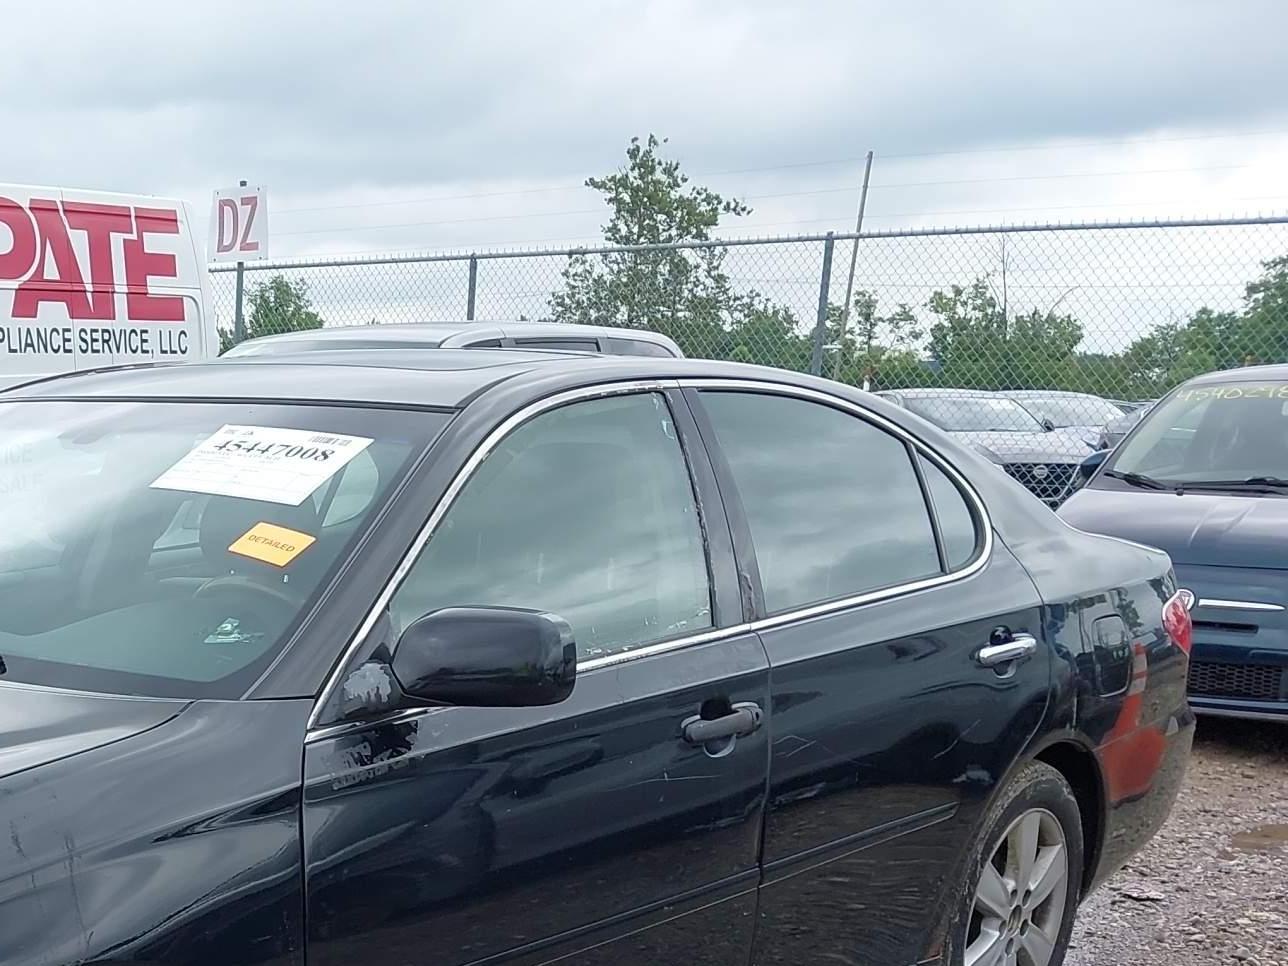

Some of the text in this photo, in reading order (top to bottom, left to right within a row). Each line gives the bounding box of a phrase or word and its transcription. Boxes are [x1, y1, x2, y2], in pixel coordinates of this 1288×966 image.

[216, 196, 259, 253] DZ
[78, 328, 154, 358] SERVICE,
[159, 329, 188, 355] LLC
[214, 440, 336, 462] 45447008
[248, 534, 296, 553] DETAILED
